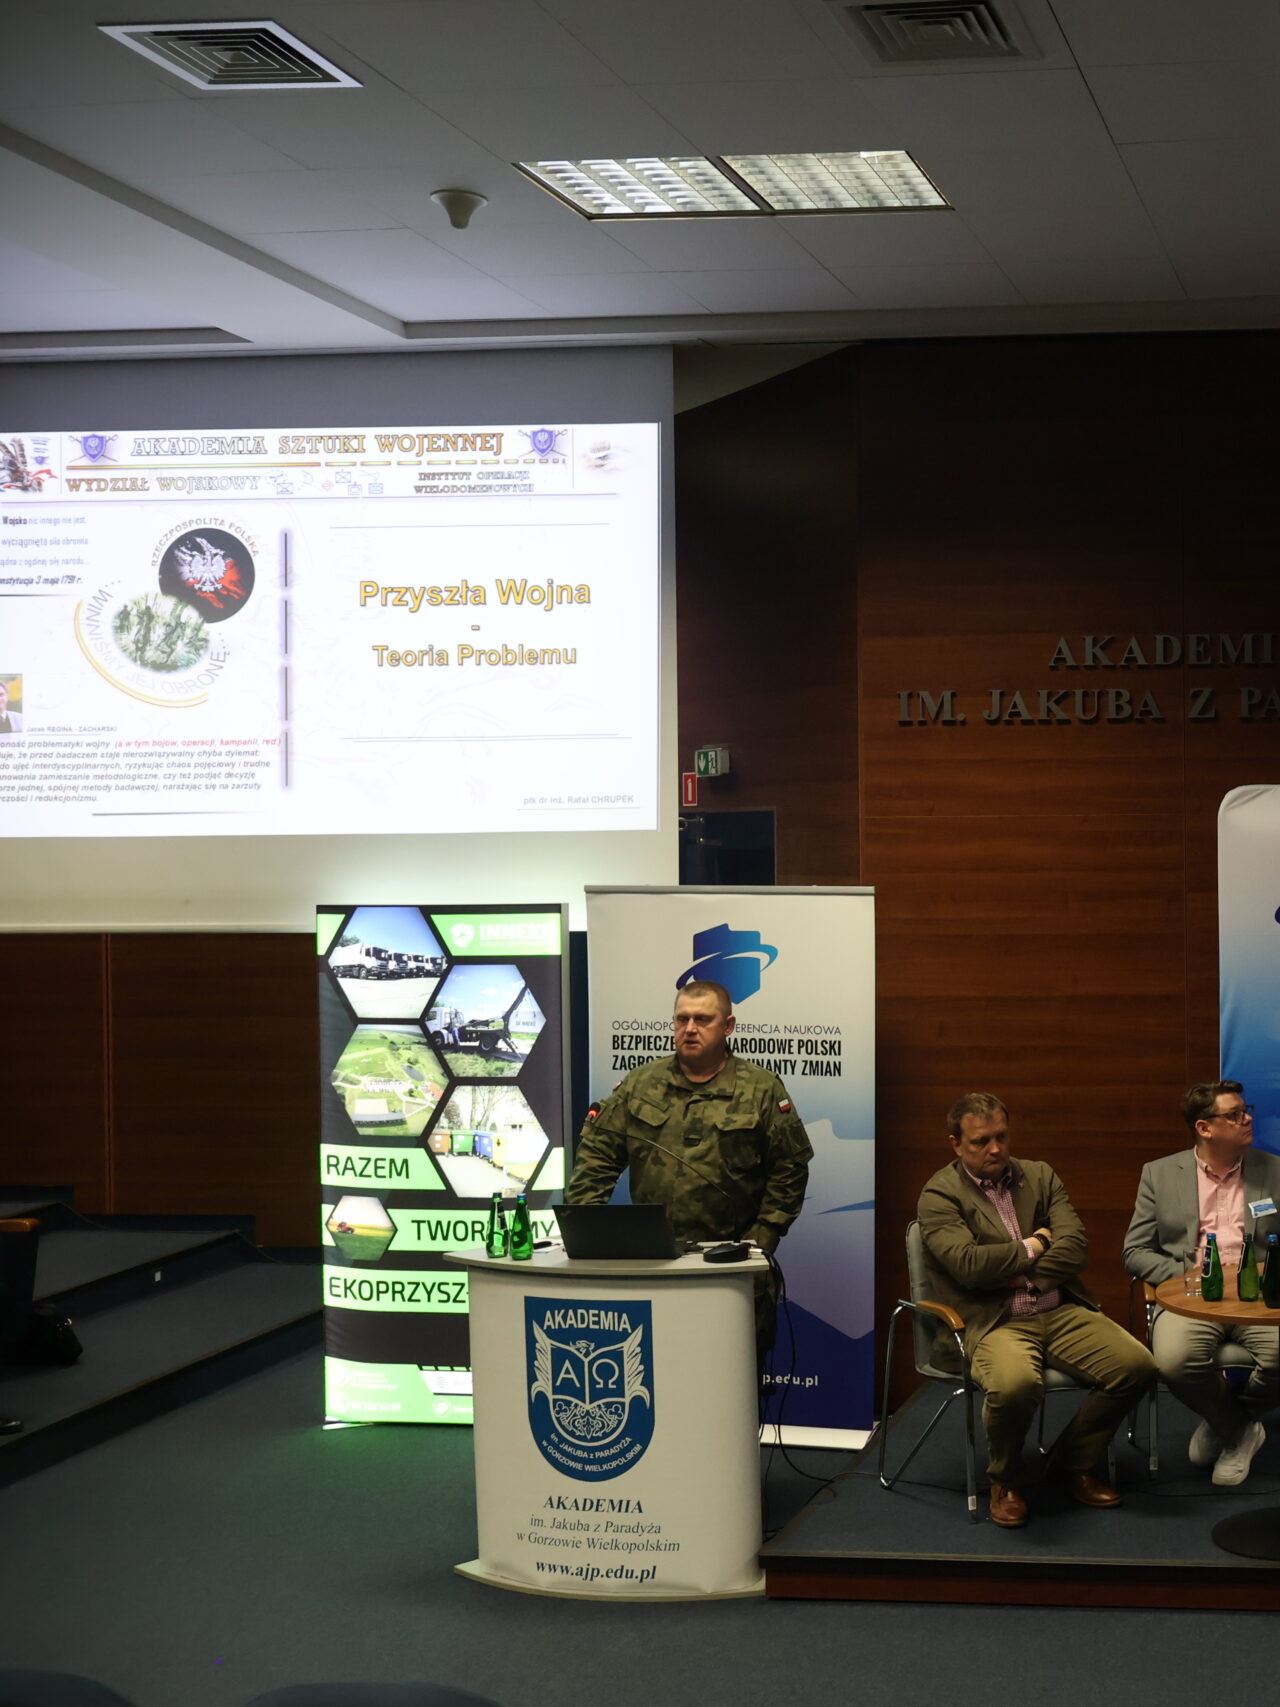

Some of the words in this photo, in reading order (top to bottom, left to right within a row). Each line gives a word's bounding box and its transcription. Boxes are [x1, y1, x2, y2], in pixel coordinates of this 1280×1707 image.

[131, 436, 268, 456] AKADEMIA
[279, 435, 365, 454] SZTUKI
[375, 432, 504, 456] WOJENNEJ
[65, 477, 150, 493] WYDZIAŁ
[156, 475, 261, 494] WOJSKOWY
[418, 471, 472, 481] INSTYTUT
[228, 521, 260, 557] POLSKA
[359, 579, 487, 613] Przyszła
[495, 578, 592, 611] Wojna
[372, 644, 449, 667] Teoria
[457, 643, 578, 666] Problemu
[897, 689, 968, 724] IM.
[983, 689, 1164, 724] JAKUBA
[1188, 687, 1218, 722] Z
[27, 739, 84, 749] problematyki
[85, 740, 110, 749] wojny
[166, 760, 192, 769] chaos
[243, 759, 271, 768] trudne
[591, 793, 635, 804] CHRUPEK
[736, 1022, 782, 1035] ERENCJA
[784, 1024, 842, 1036] NAUKOWA
[612, 1034, 676, 1051] BEZPIECZE
[797, 1039, 842, 1056] POLSKI
[801, 1059, 842, 1077] ZMIAN
[326, 1154, 410, 1180] RAZEM
[328, 1276, 468, 1304] EKOPRZYSZ
[543, 1308, 632, 1334] AKADEMIA
[762, 1372, 819, 1388] p.edu.pl
[547, 1446, 584, 1472] GORZOWIE
[584, 1443, 643, 1473] WIELKOPOLSKIM
[559, 1442, 589, 1459] JAKUBA
[595, 1436, 633, 1459] PARADYŻA
[543, 1495, 645, 1514] AKADEMIA
[530, 1513, 547, 1528] im.
[550, 1516, 590, 1532] Jakuba
[593, 1522, 601, 1533] z
[604, 1520, 662, 1537] Paradyża
[516, 1531, 526, 1542] w
[528, 1531, 583, 1550] Gorzowie
[586, 1536, 681, 1554] Wielkopolskim
[536, 1560, 657, 1583] www.ajp.edu.pl
